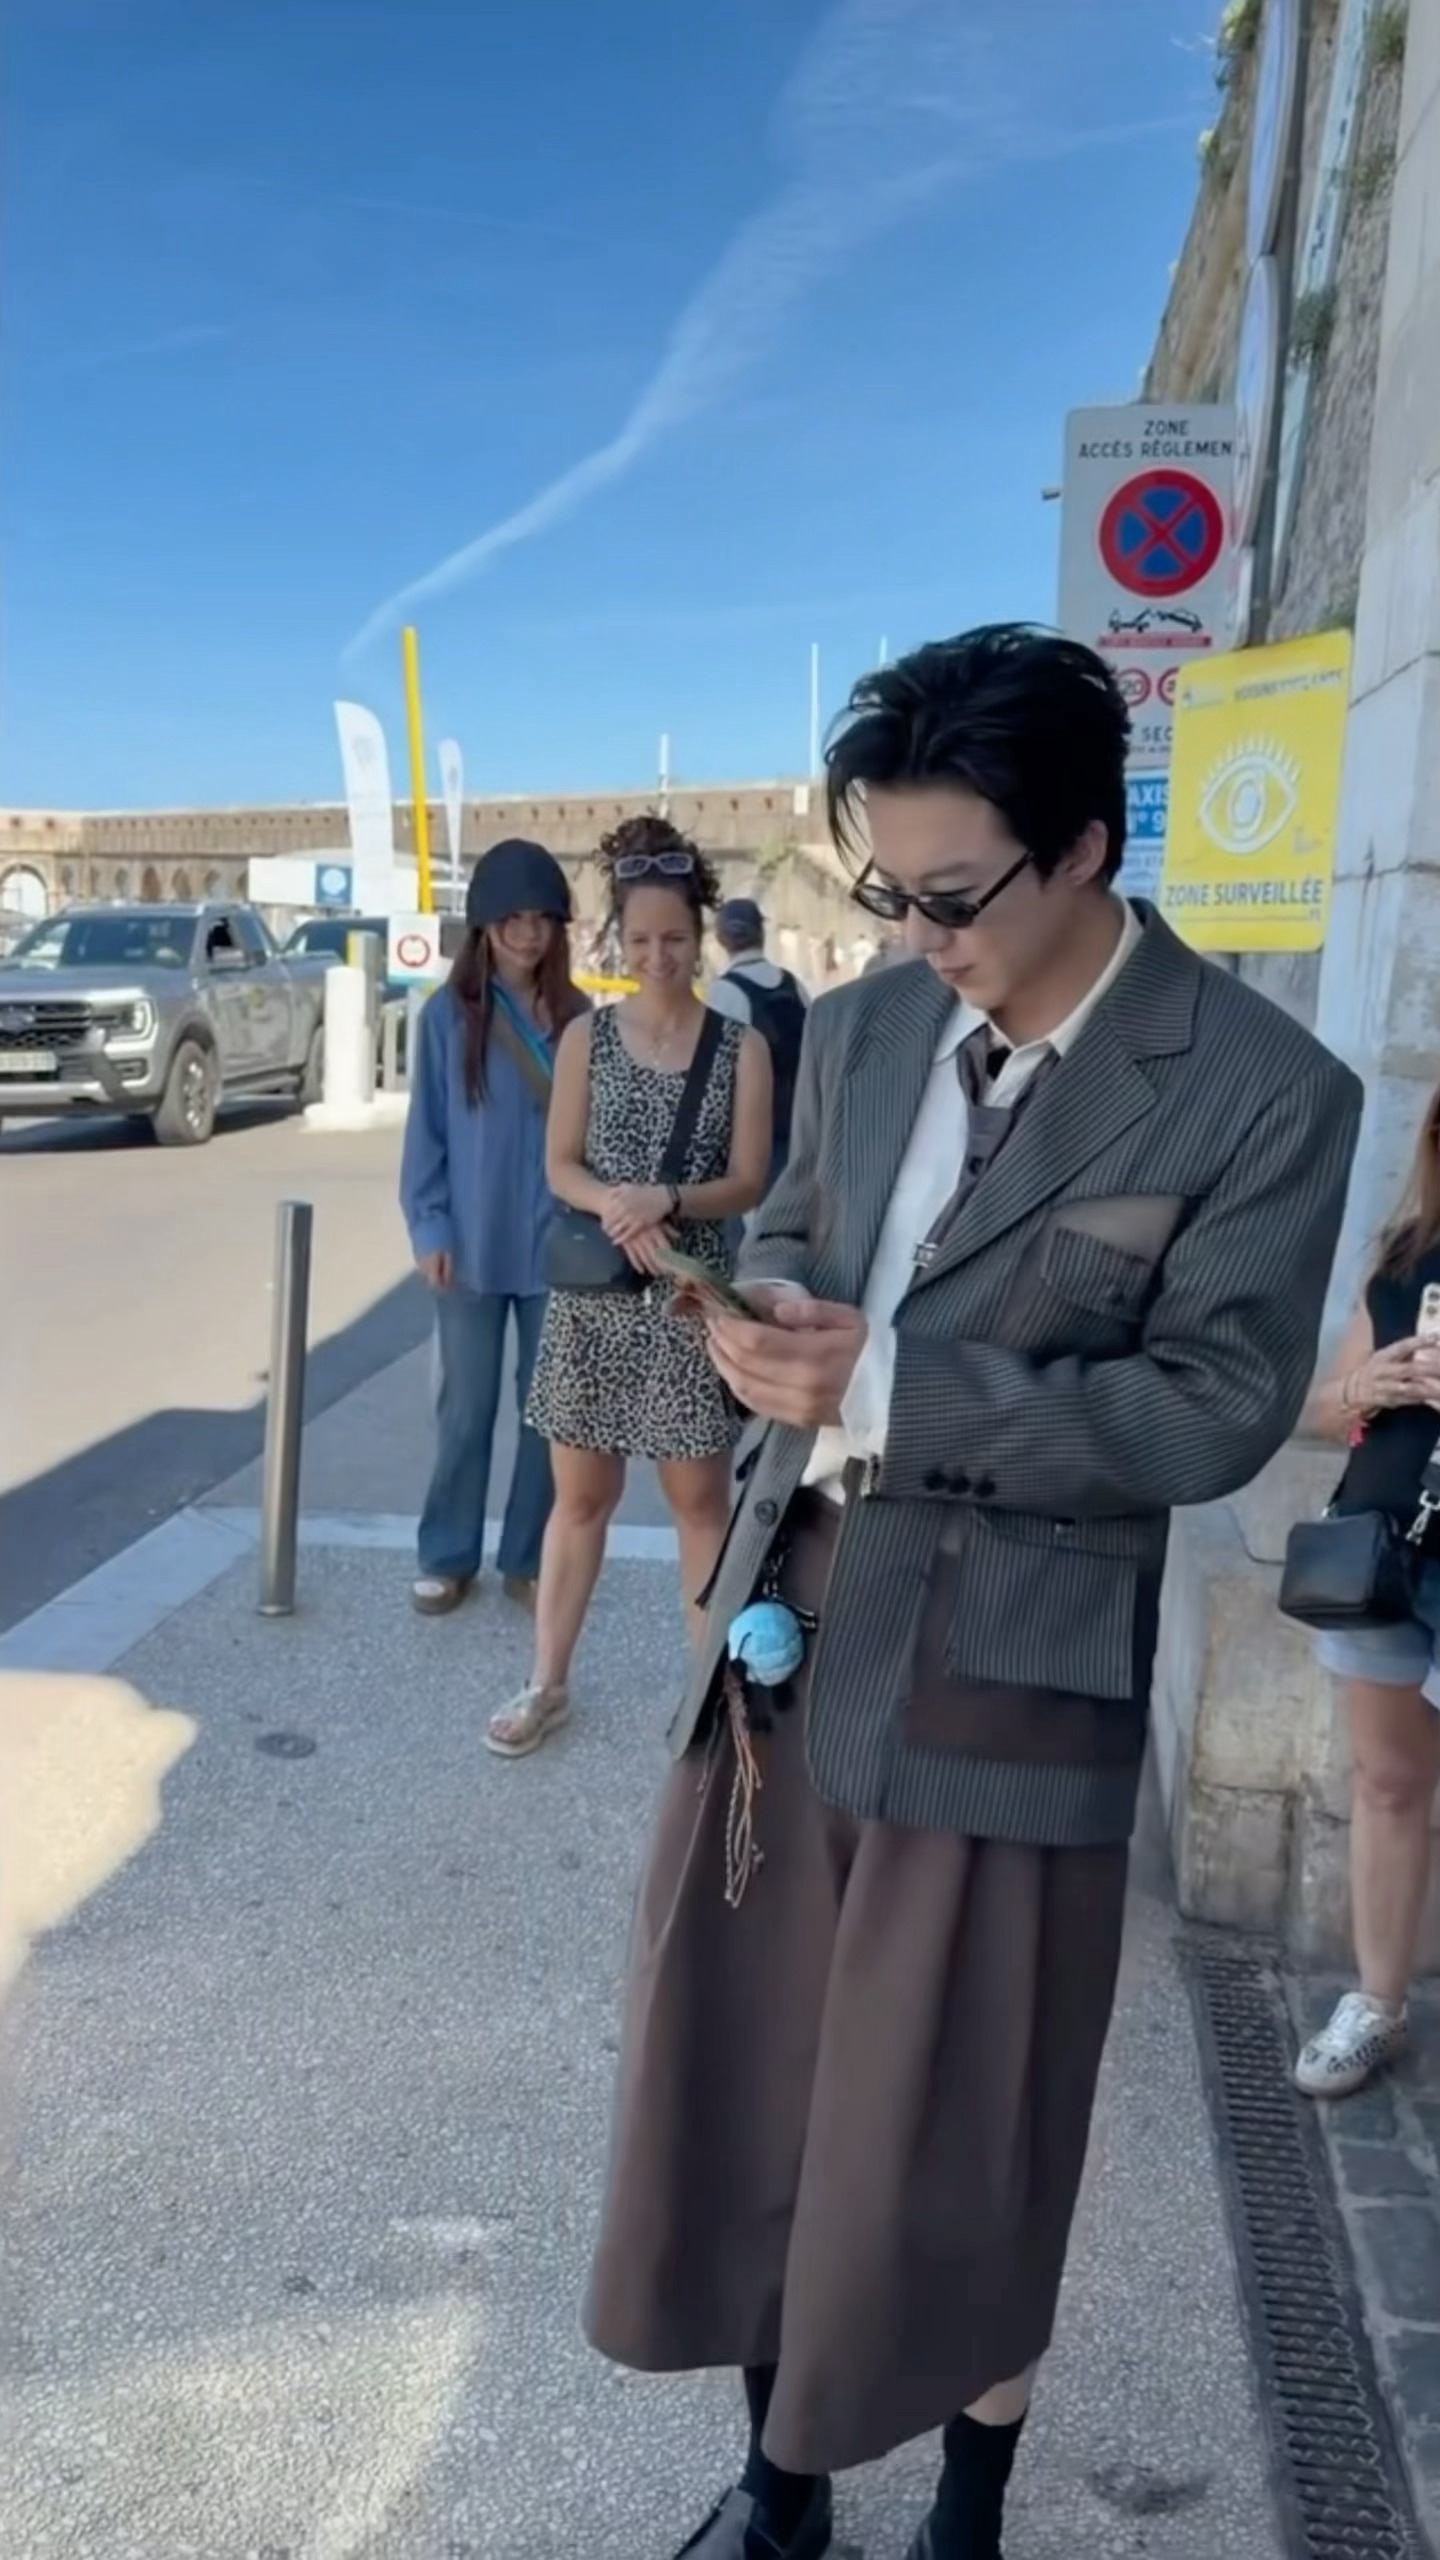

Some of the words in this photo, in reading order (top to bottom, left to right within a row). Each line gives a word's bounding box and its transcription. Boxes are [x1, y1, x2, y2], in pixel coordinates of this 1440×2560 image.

[1144, 420, 1189, 436] ZONE
[1166, 884, 1210, 907] ZONE
[1213, 875, 1323, 905] SURVEILLÉE
